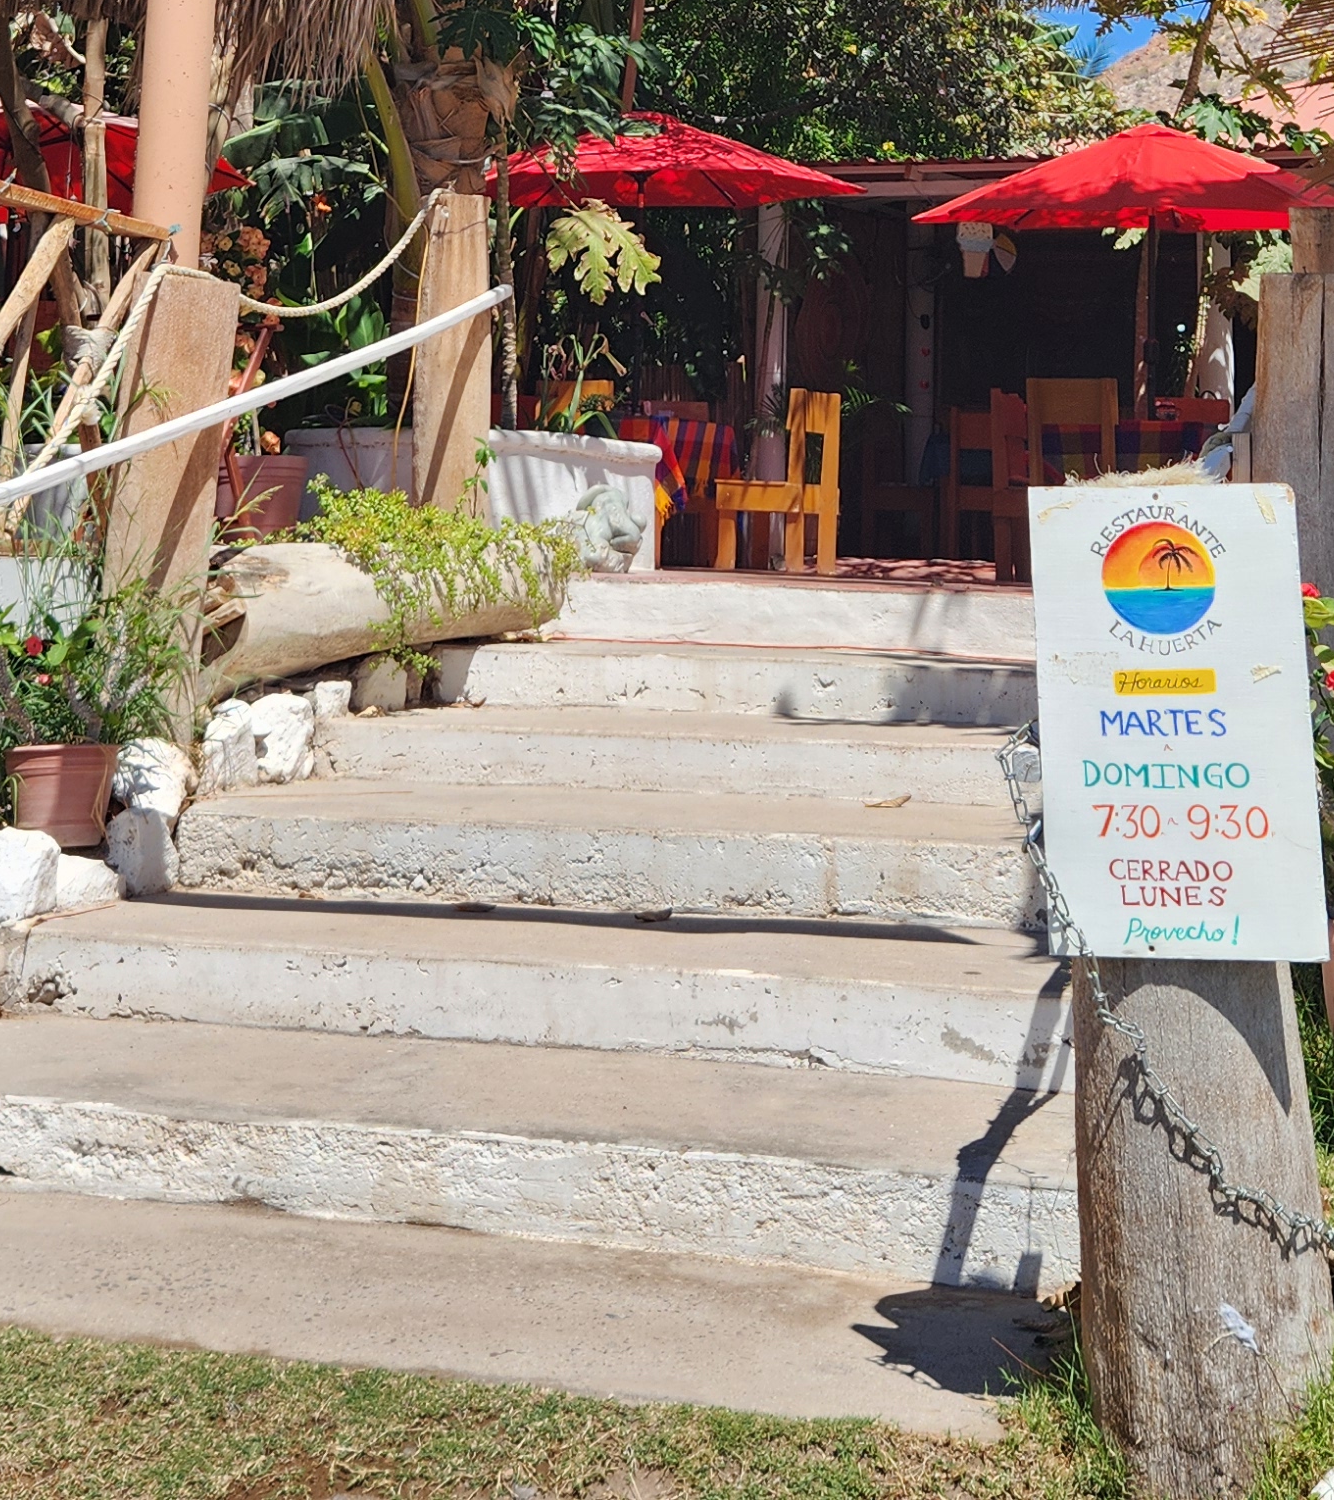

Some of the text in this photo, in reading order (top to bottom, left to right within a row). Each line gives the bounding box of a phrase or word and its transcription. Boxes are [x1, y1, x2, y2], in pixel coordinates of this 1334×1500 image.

[1090, 505, 1227, 559] RESTAURANTE
[1118, 672, 1203, 693] Horarios
[1099, 709, 1227, 737] MARTES
[1082, 760, 1250, 789] DOMINGO
[1109, 859, 1233, 882] CERRADO
[1120, 885, 1227, 907] LUNES
